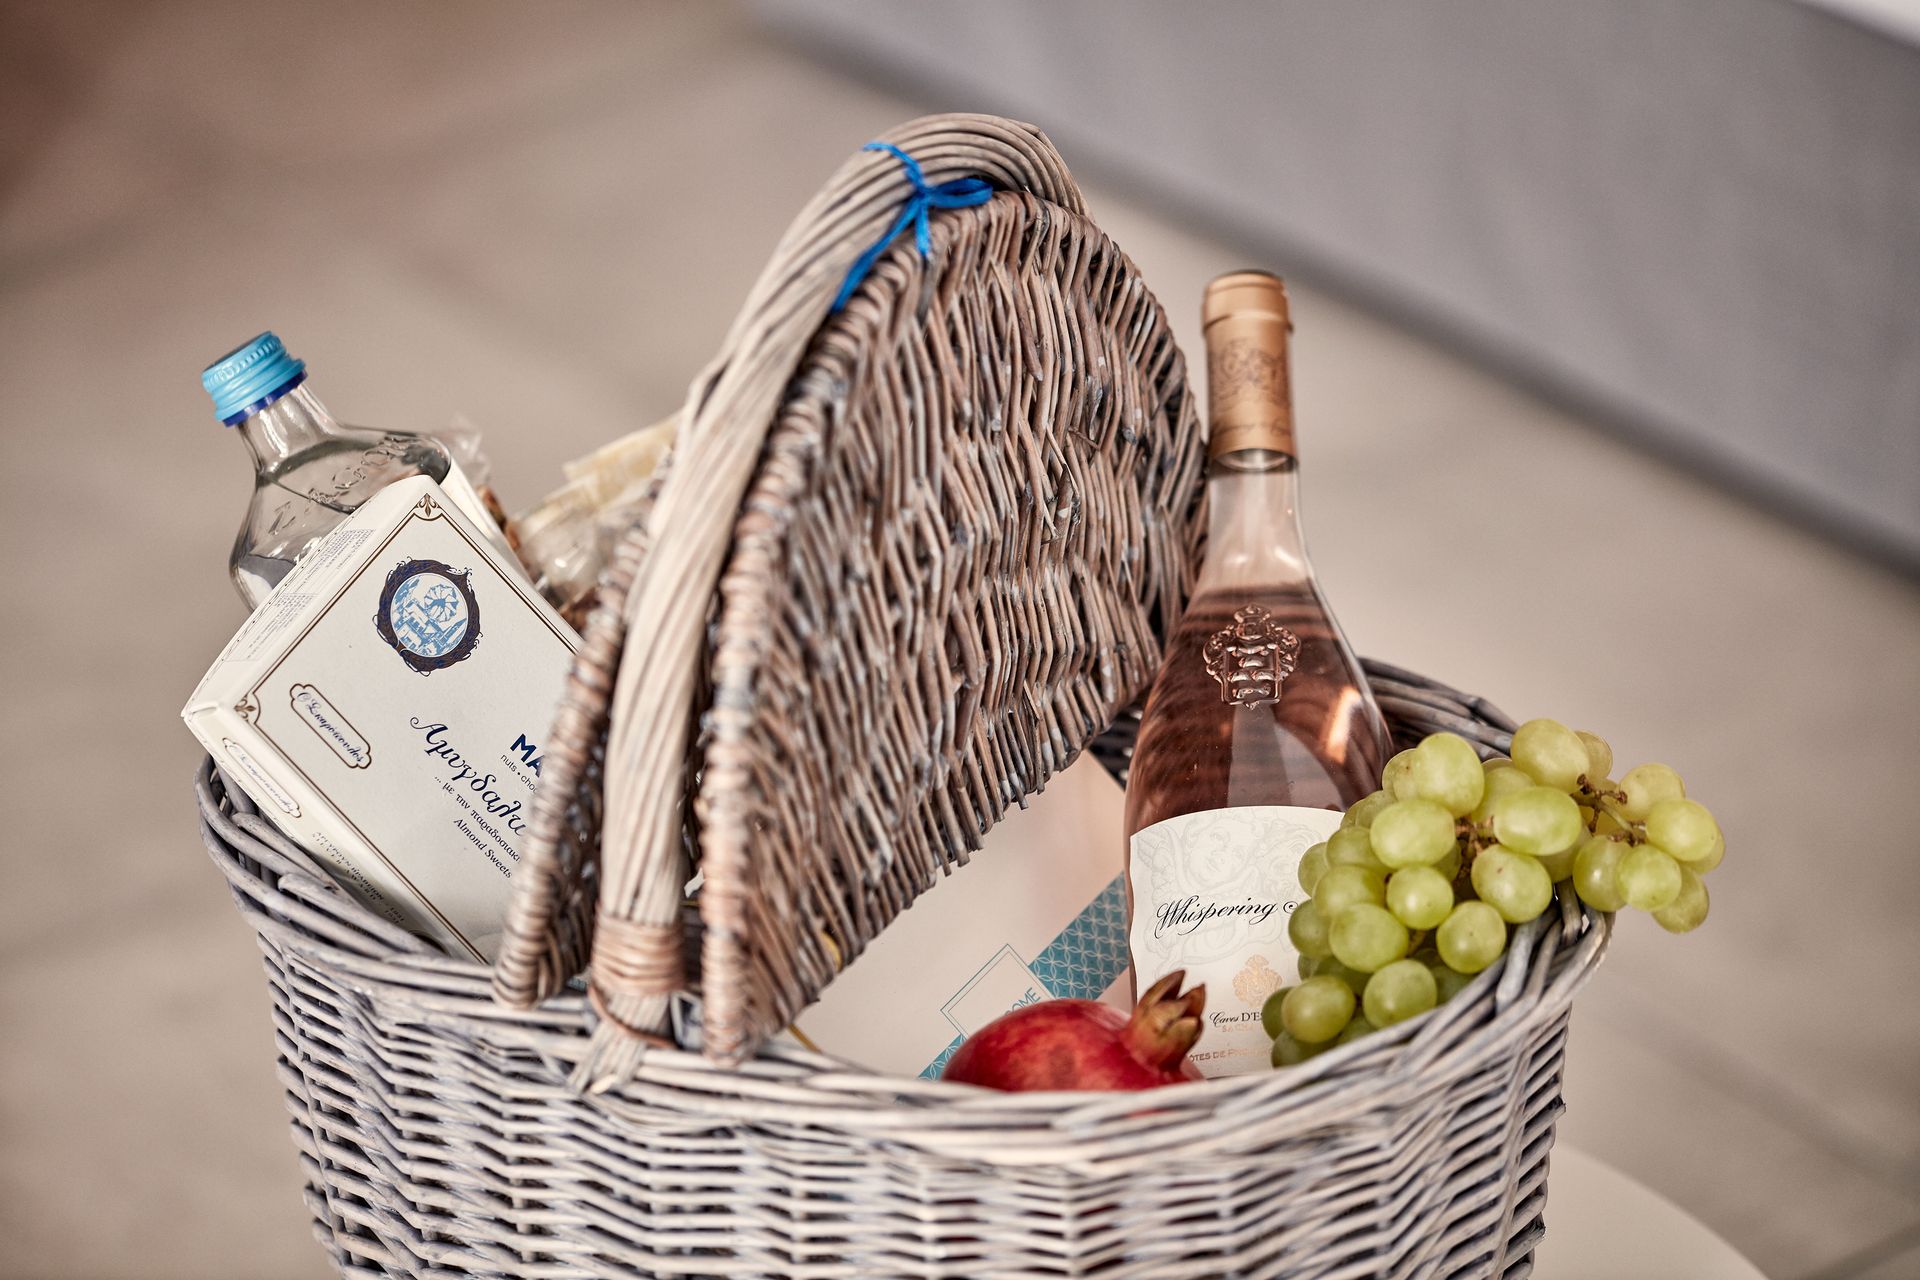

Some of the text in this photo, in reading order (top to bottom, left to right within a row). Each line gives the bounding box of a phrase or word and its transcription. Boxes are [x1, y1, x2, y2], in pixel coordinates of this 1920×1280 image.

[500, 754, 517, 772] nuts
[453, 818, 512, 878] Almond Sweets
[1154, 895, 1278, 939] Whispering
[1241, 1011, 1263, 1022] D'E
